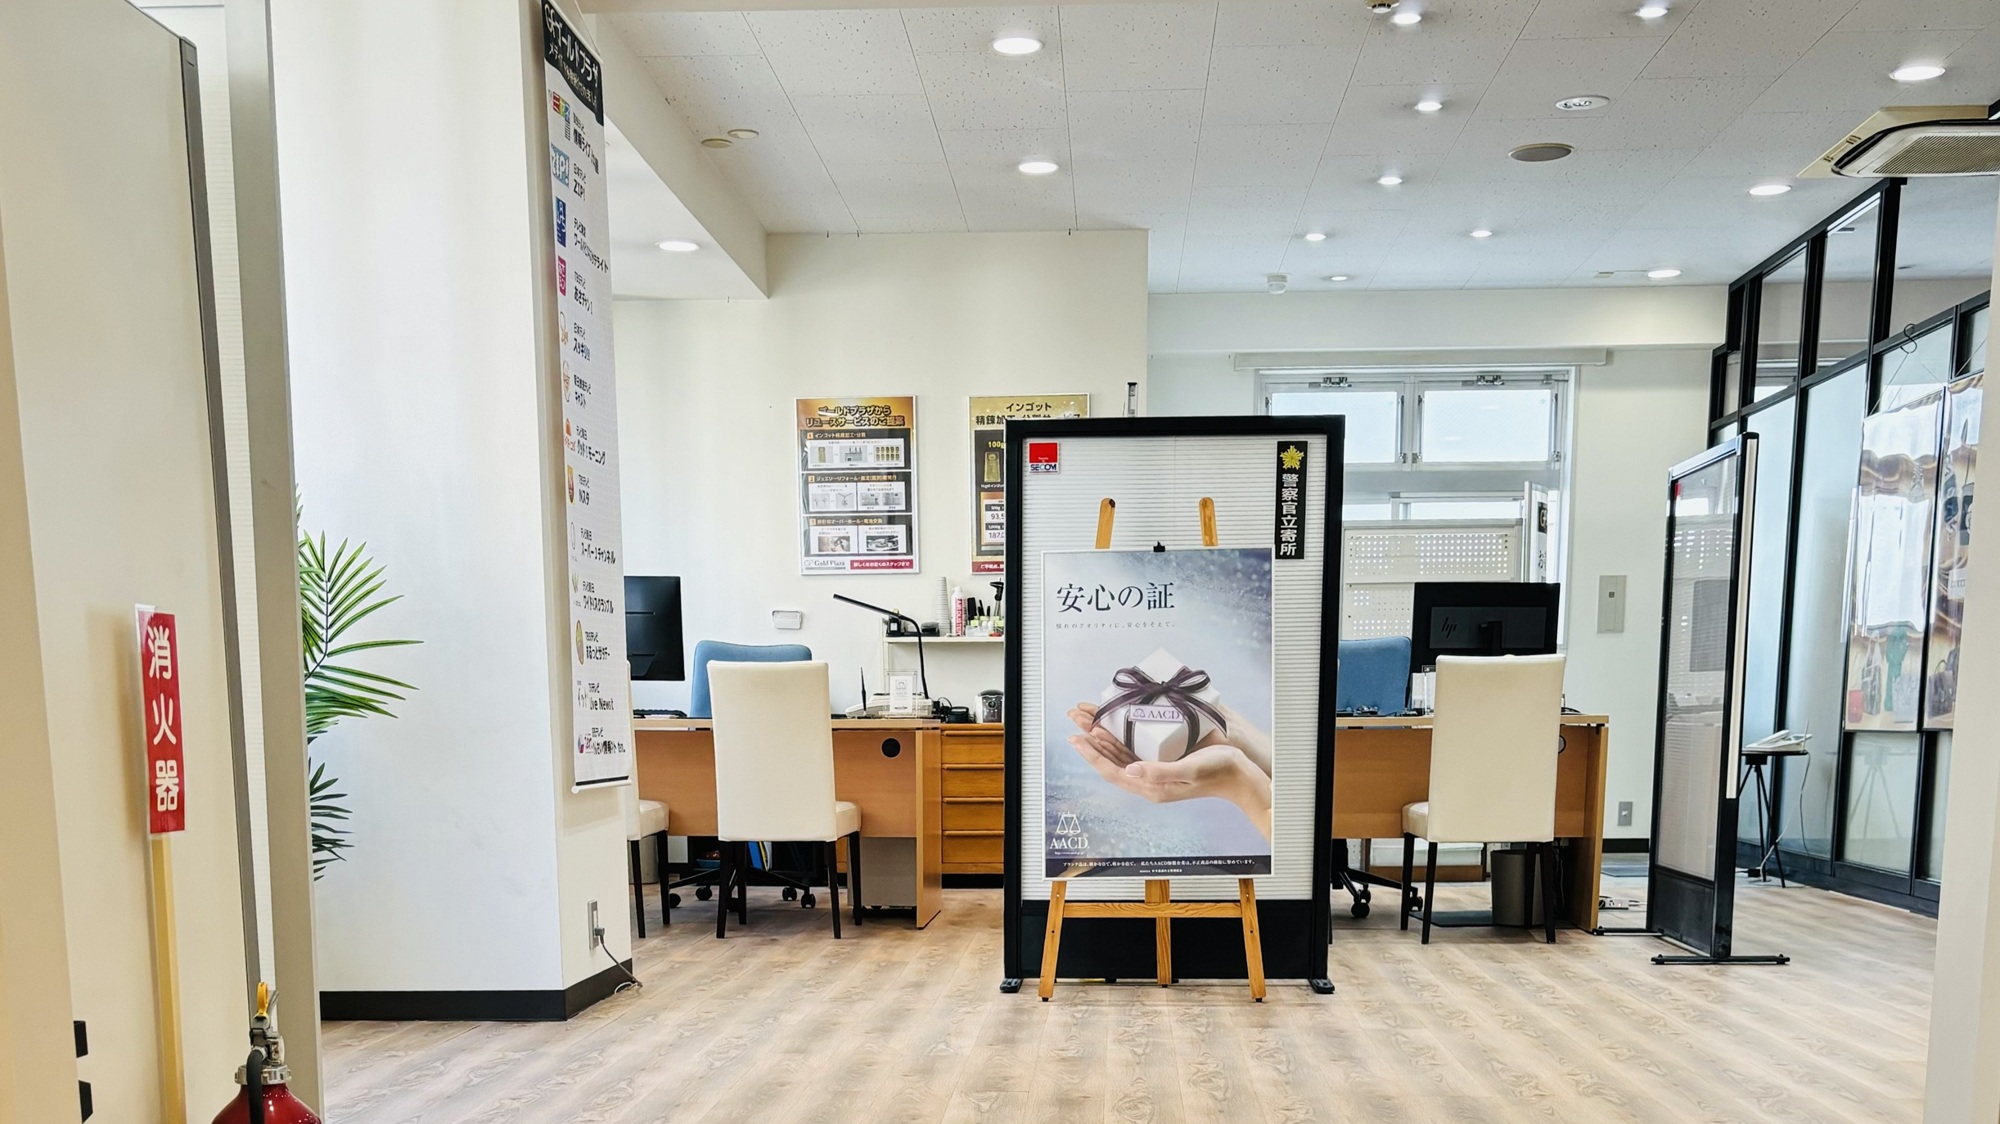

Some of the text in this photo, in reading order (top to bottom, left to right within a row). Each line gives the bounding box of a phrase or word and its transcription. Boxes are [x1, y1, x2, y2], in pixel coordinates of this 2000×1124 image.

[818, 405, 892, 416] ゴールドプラザから
[1006, 402, 1052, 412] インゴット
[1030, 463, 1057, 471] SECOM
[1280, 473, 1299, 556] 警察官立寄所
[1056, 582, 1175, 613] 安心の証
[1441, 617, 1458, 638] hp
[147, 625, 179, 812] 消火器
[1147, 711, 1180, 720] AACD
